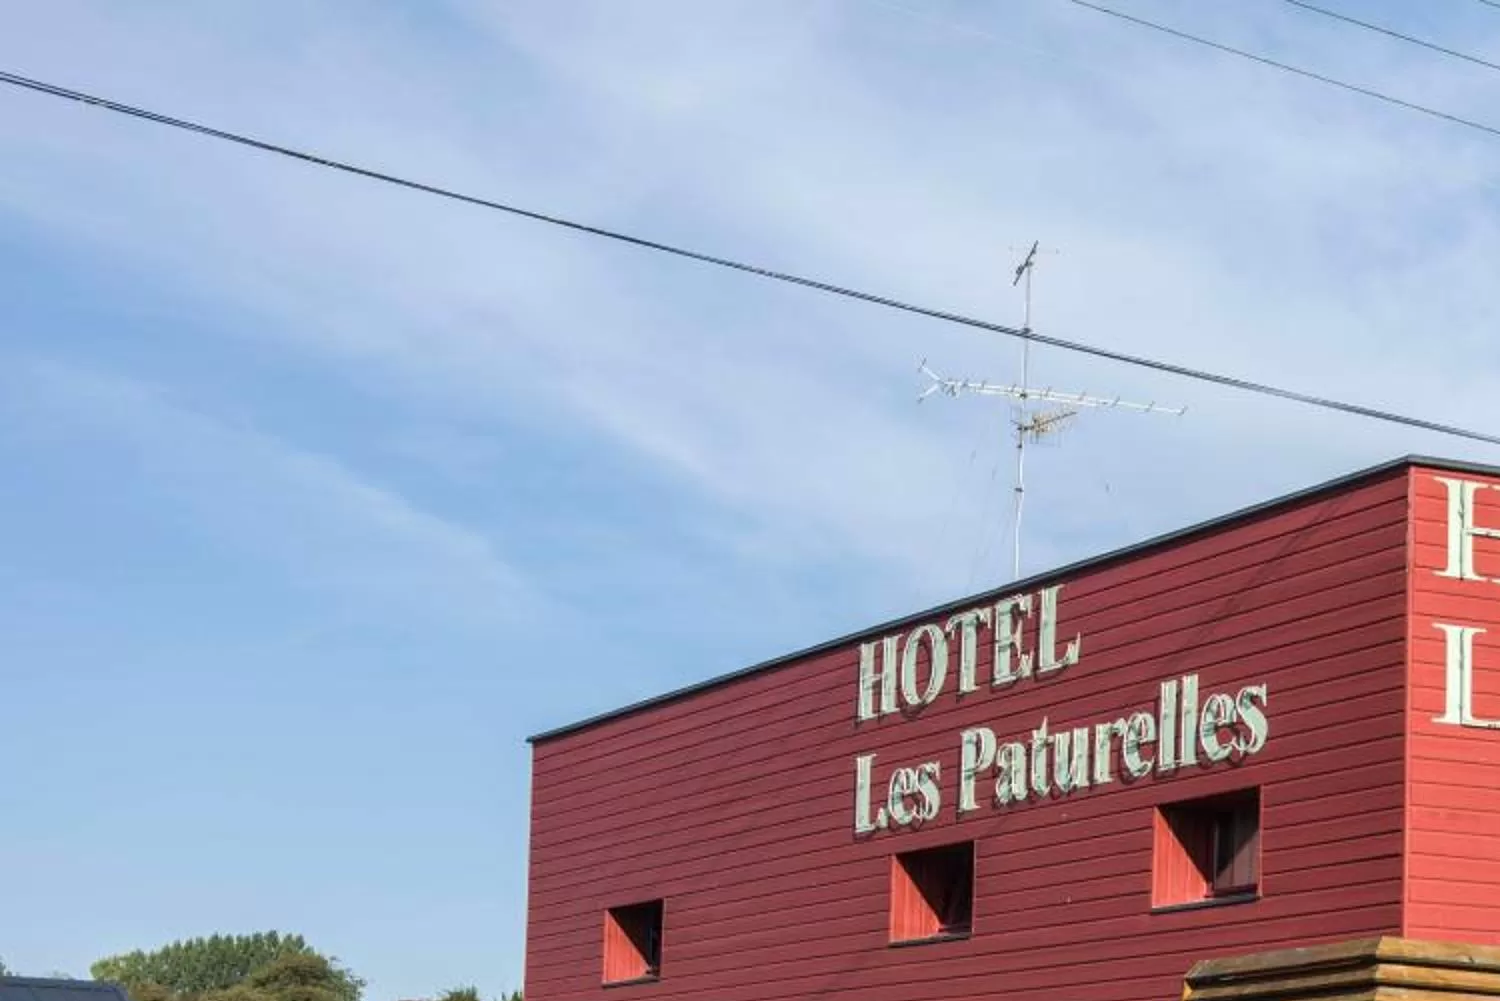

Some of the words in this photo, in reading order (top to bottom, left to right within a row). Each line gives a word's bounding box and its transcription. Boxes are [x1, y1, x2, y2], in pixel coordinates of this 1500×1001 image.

[855, 584, 1081, 723] HOTEL
[853, 753, 941, 834] Les
[957, 674, 1269, 813] Paturelles
